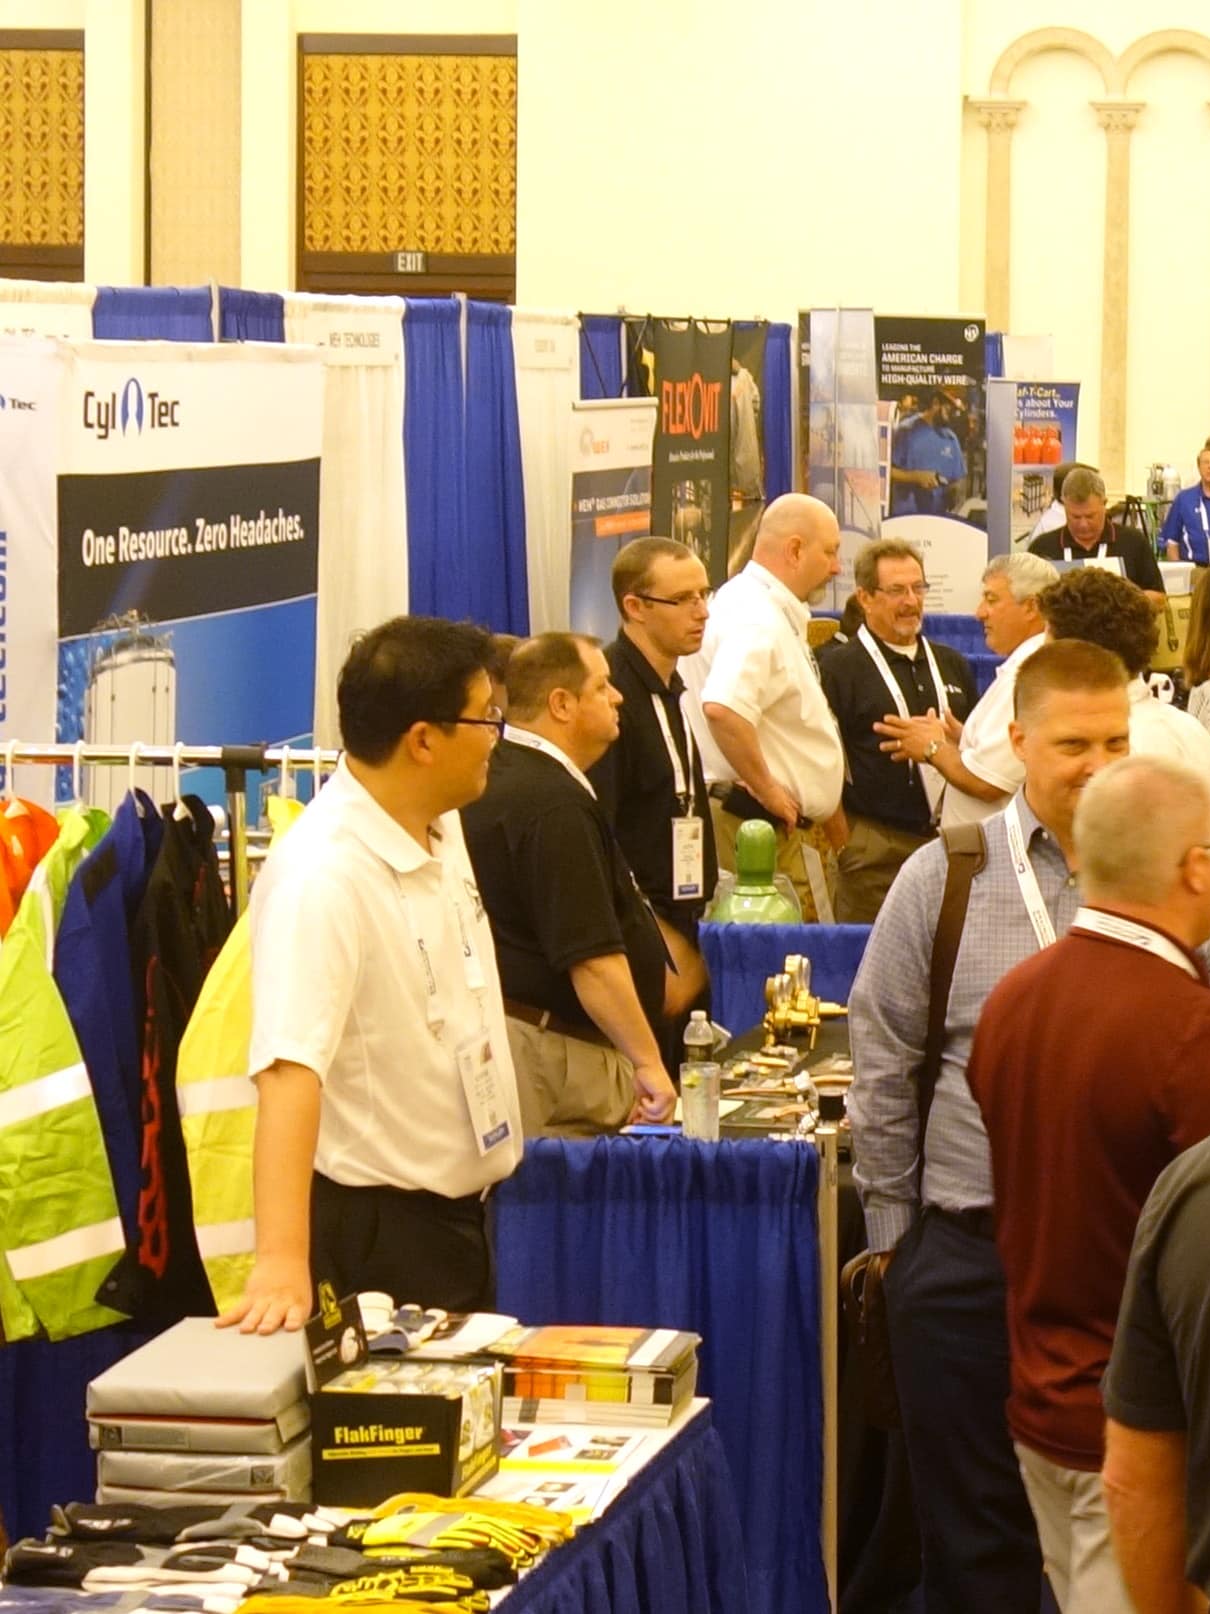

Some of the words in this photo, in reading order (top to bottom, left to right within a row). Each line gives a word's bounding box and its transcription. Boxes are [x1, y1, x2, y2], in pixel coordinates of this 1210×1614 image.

[398, 253, 423, 272] EXIT
[909, 344, 922, 353] THE
[881, 353, 928, 364] AMERICAN
[929, 354, 963, 365] CHARGE
[881, 374, 942, 386] HIGH-QUALITY
[943, 375, 968, 385] WIRE
[9, 398, 37, 410] Tec
[662, 371, 721, 440] FLEXOVIT
[1025, 398, 1051, 408] about
[1053, 399, 1074, 408] Your
[83, 391, 117, 439] Cyl
[148, 392, 180, 429] Tec
[82, 529, 115, 567] One
[118, 526, 192, 563] Resource.
[195, 518, 228, 553] Zero
[230, 508, 304, 549] Headaches.
[334, 1424, 423, 1444] FlakFinger
